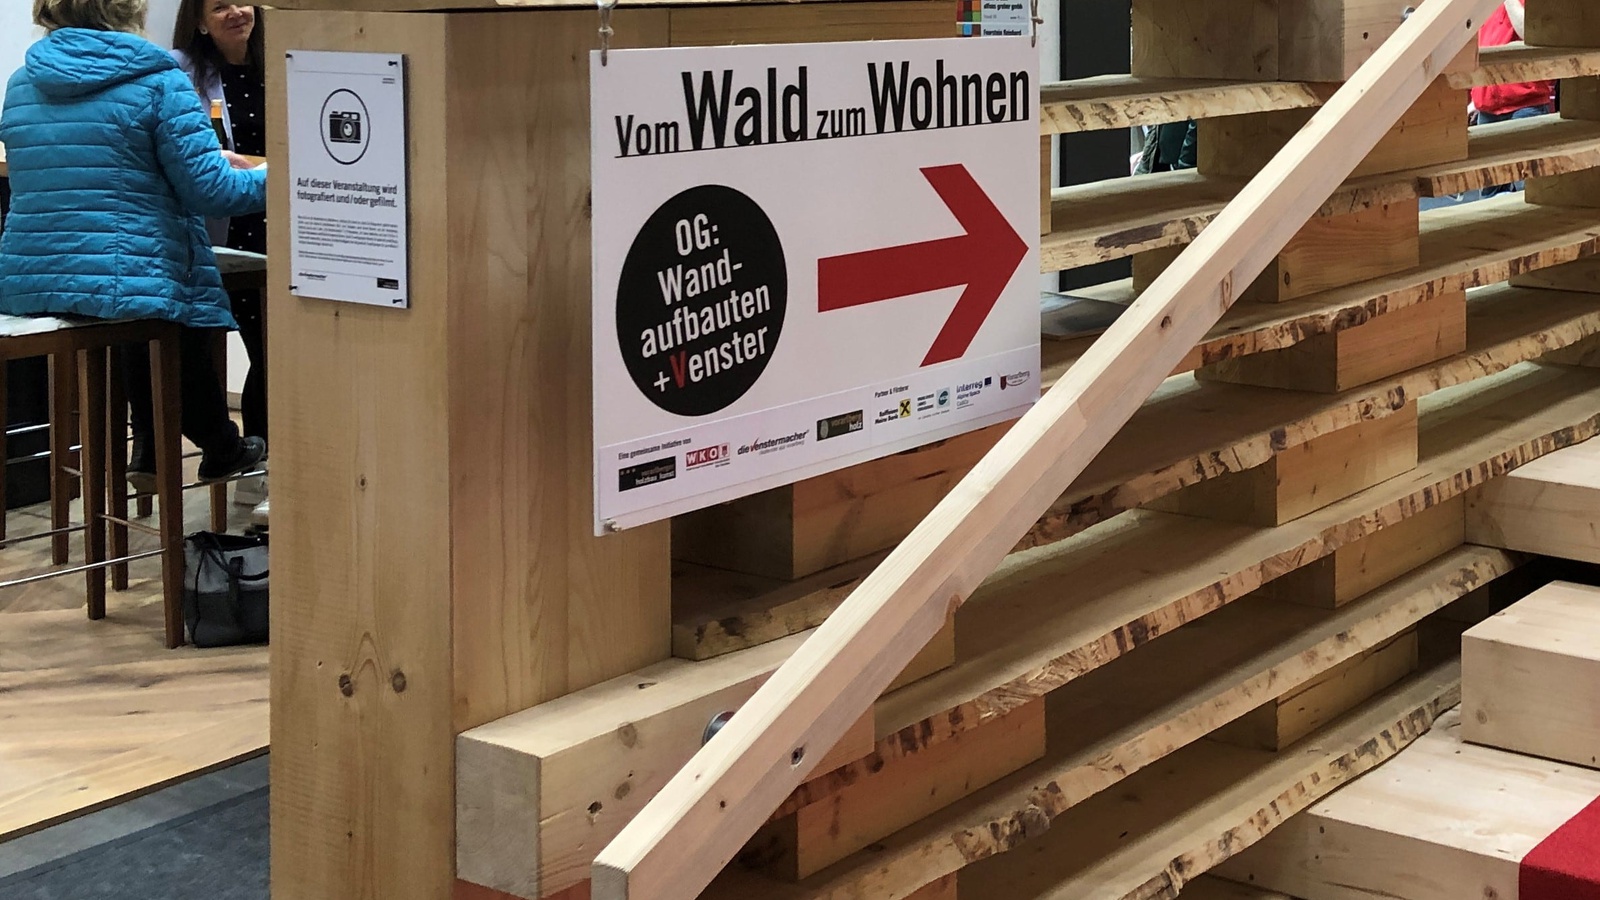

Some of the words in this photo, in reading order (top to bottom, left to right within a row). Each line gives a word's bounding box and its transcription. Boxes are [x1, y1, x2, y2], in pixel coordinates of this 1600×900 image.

[615, 115, 679, 156] Vom
[681, 66, 808, 150] Wald
[816, 106, 866, 139] zum
[867, 59, 1030, 131] Wohnen
[297, 177, 309, 187] Auf
[310, 178, 331, 189] dieser
[332, 180, 380, 195] Veranstaltung
[382, 184, 397, 194] wird
[297, 190, 335, 202] fotografiert
[675, 213, 720, 256] OG:
[657, 248, 743, 306] Wand-
[640, 284, 771, 358] aufbauten
[669, 326, 768, 389] Venster
